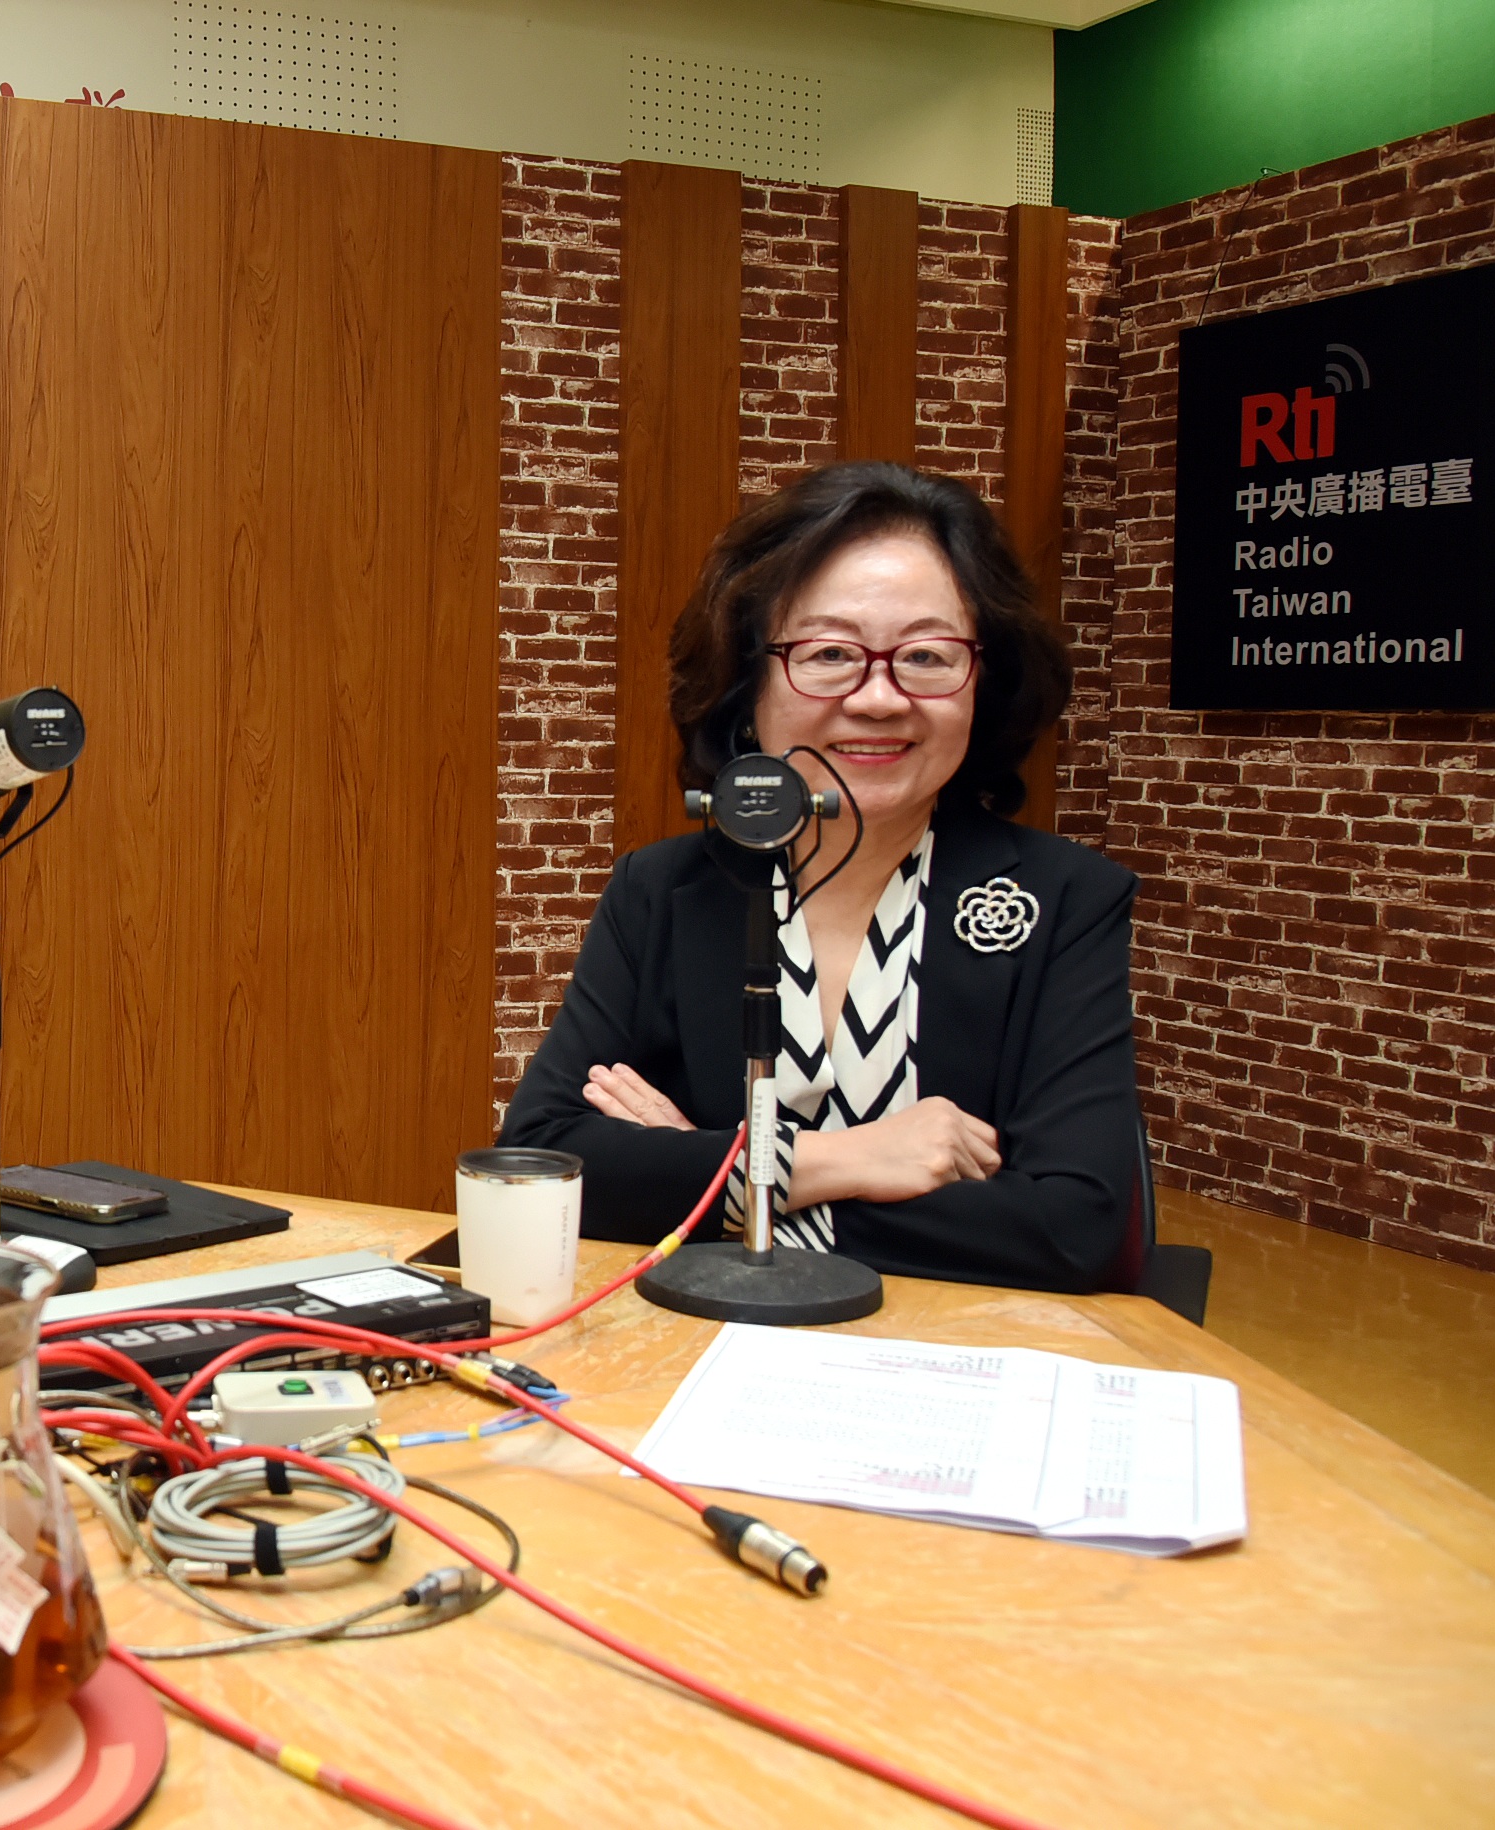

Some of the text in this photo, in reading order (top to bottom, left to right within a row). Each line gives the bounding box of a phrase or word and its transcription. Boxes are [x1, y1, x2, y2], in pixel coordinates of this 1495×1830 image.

[1235, 457, 1474, 524] 中央廣播電臺
[1234, 535, 1334, 571] Radio
[1232, 586, 1352, 619] Taiwan
[1231, 628, 1464, 666] International
